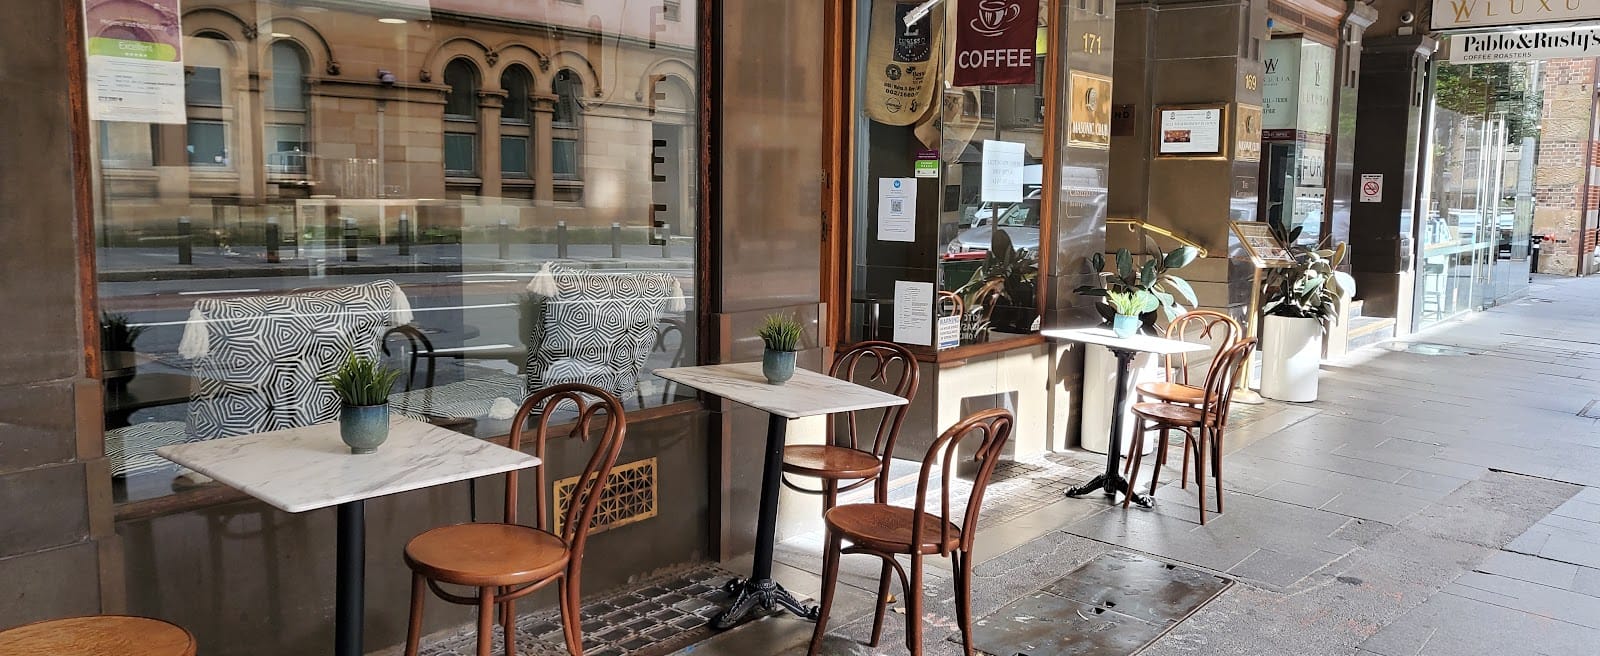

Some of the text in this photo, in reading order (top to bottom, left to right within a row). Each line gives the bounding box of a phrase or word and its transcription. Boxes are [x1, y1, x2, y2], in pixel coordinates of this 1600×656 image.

[1082, 32, 1101, 56] 171
[958, 48, 1032, 69] COFFEE
[1463, 51, 1532, 61] COFFEE ROASTERS
[1245, 73, 1257, 91] 169
[1302, 155, 1323, 180] FOR
